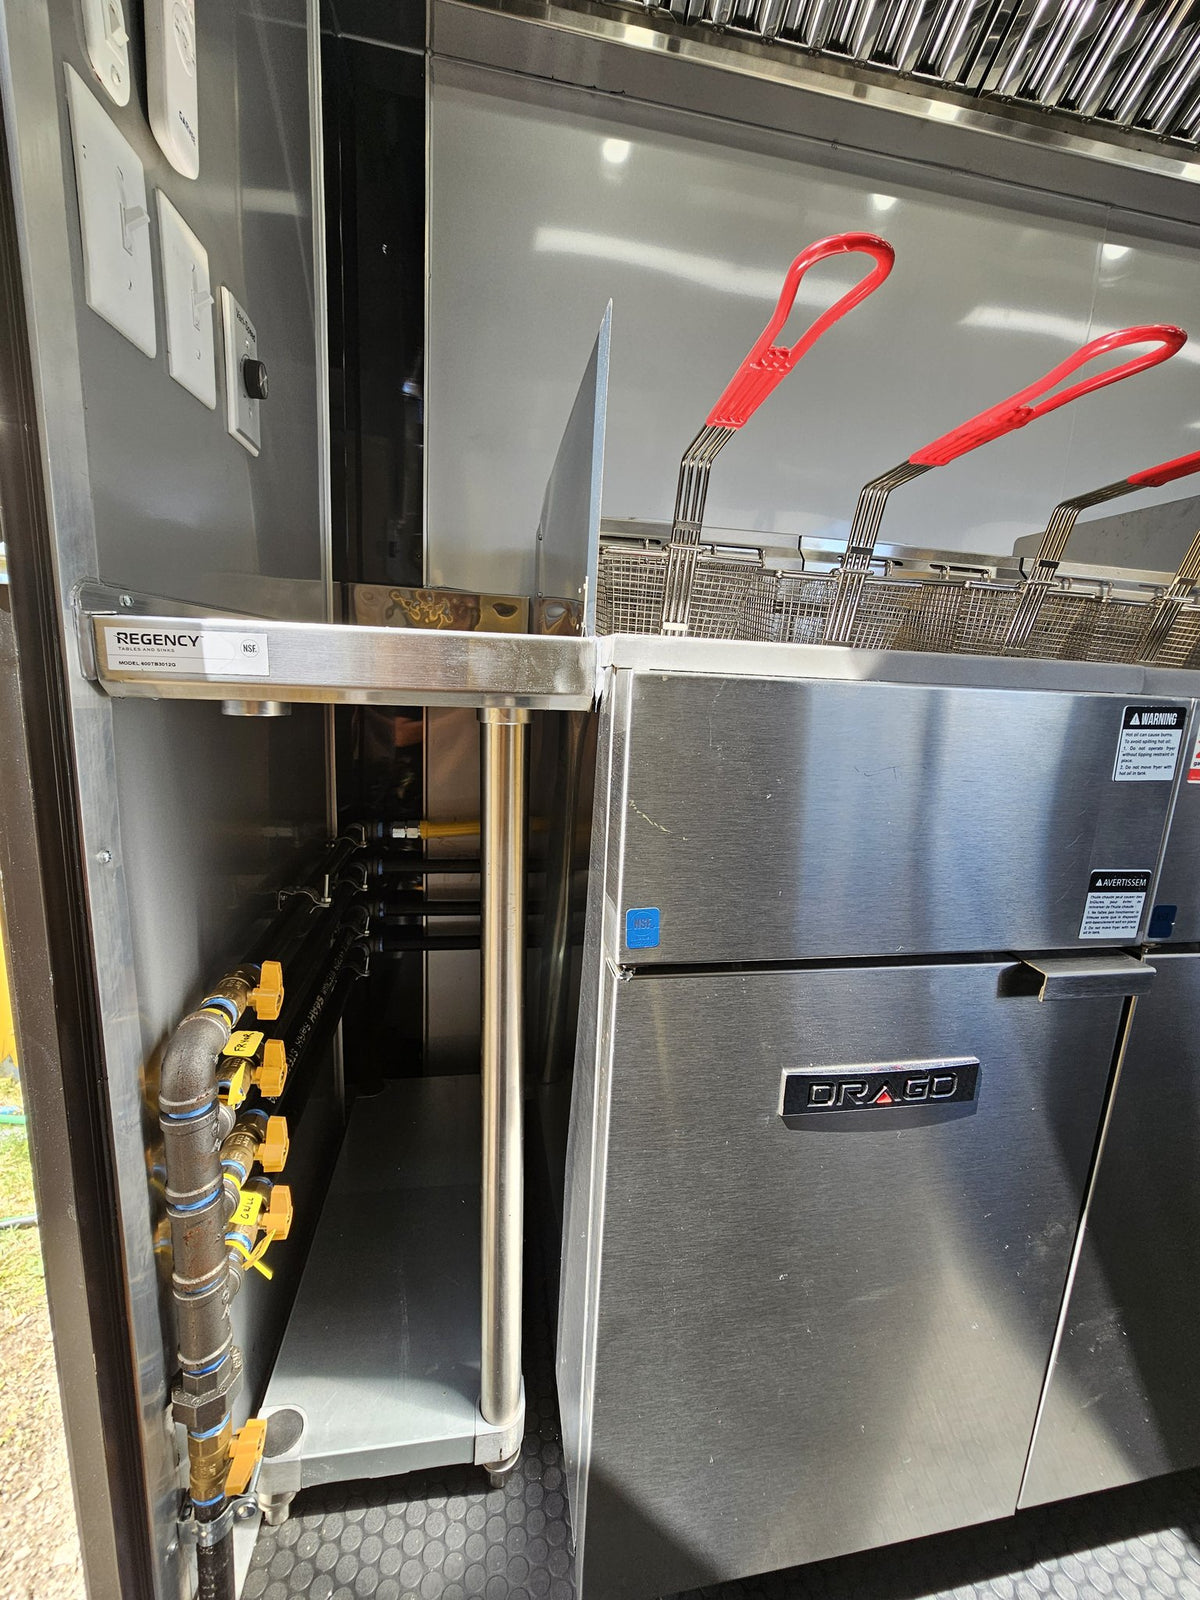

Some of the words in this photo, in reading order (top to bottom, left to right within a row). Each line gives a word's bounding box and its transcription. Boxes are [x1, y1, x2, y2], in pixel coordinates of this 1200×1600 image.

[115, 631, 200, 647] REGENCY
[1141, 712, 1178, 726] WARNING
[1102, 878, 1147, 887] AVERTISSEM
[807, 1072, 958, 1107] DRAGO
